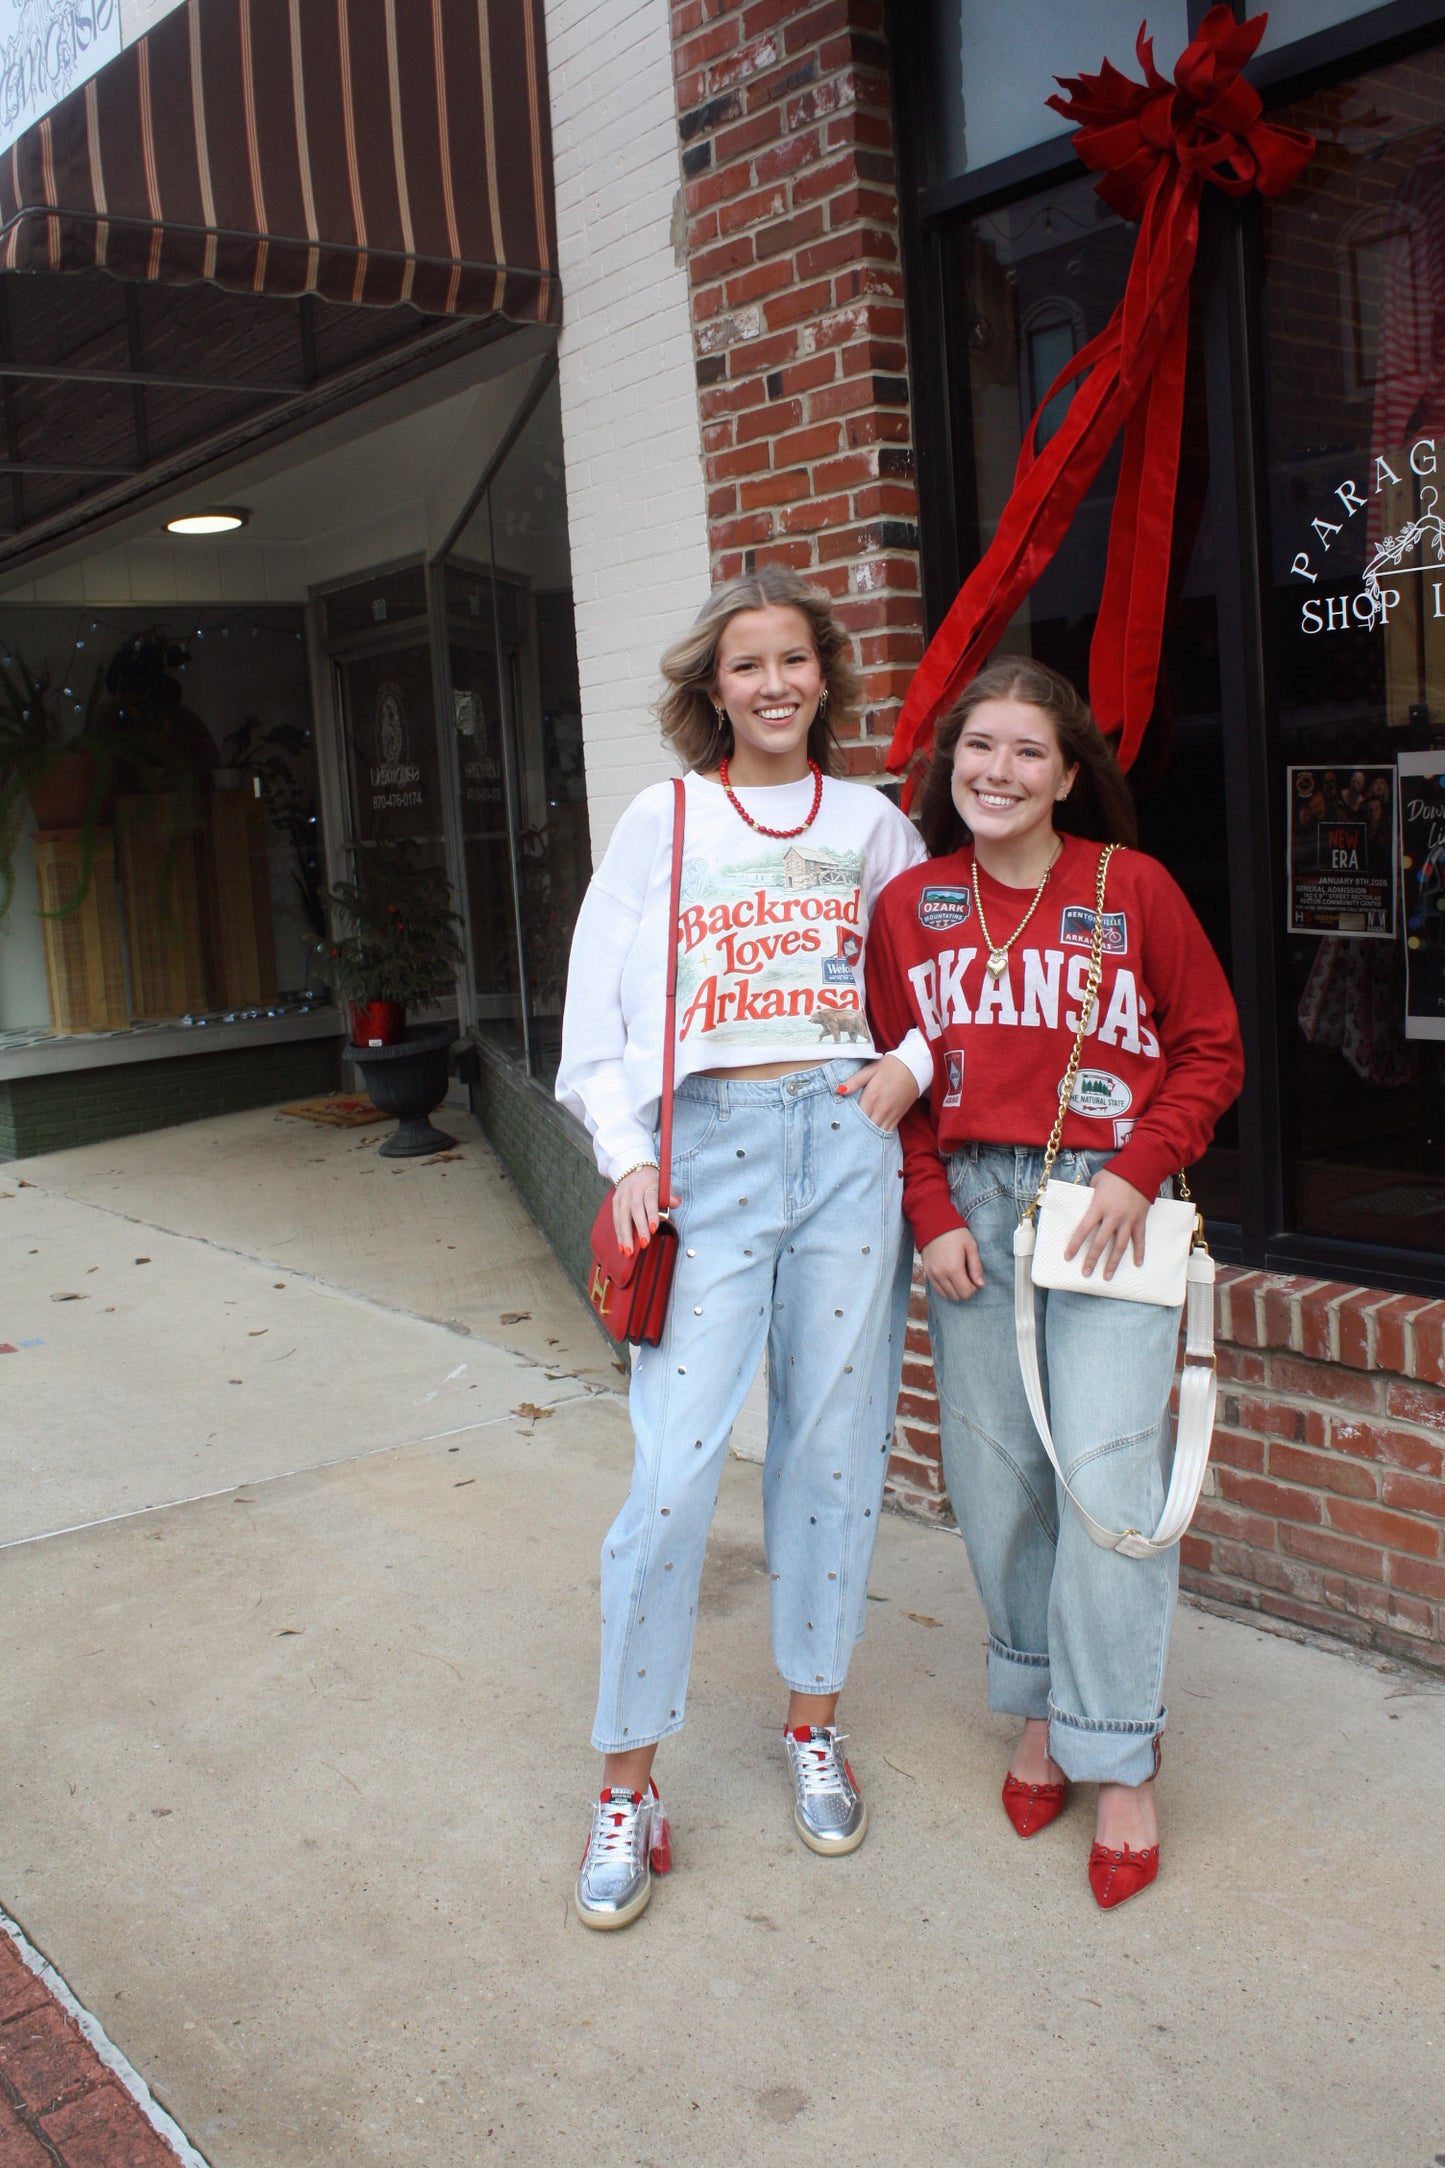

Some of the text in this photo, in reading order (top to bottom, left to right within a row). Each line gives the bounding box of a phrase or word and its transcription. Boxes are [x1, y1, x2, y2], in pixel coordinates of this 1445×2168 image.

[1291, 439, 1437, 583] PARAG
[1301, 589, 1400, 634] SHOP
[1407, 799, 1445, 822] Dow
[1328, 828, 1360, 848] NEW
[1331, 849, 1359, 870] ERA
[1295, 885, 1326, 893] GENERAL
[1327, 886, 1367, 894] ADMISSION
[1318, 877, 1354, 886] JANUARY
[924, 903, 965, 913] OZARK
[678, 889, 861, 954] Backroad
[715, 928, 821, 976] Loves
[1065, 934, 1112, 950] ARKAAS
[679, 975, 860, 1042] Arkansa
[1080, 1095, 1106, 1105] NATURAL
[1108, 1098, 1125, 1107] STATE
